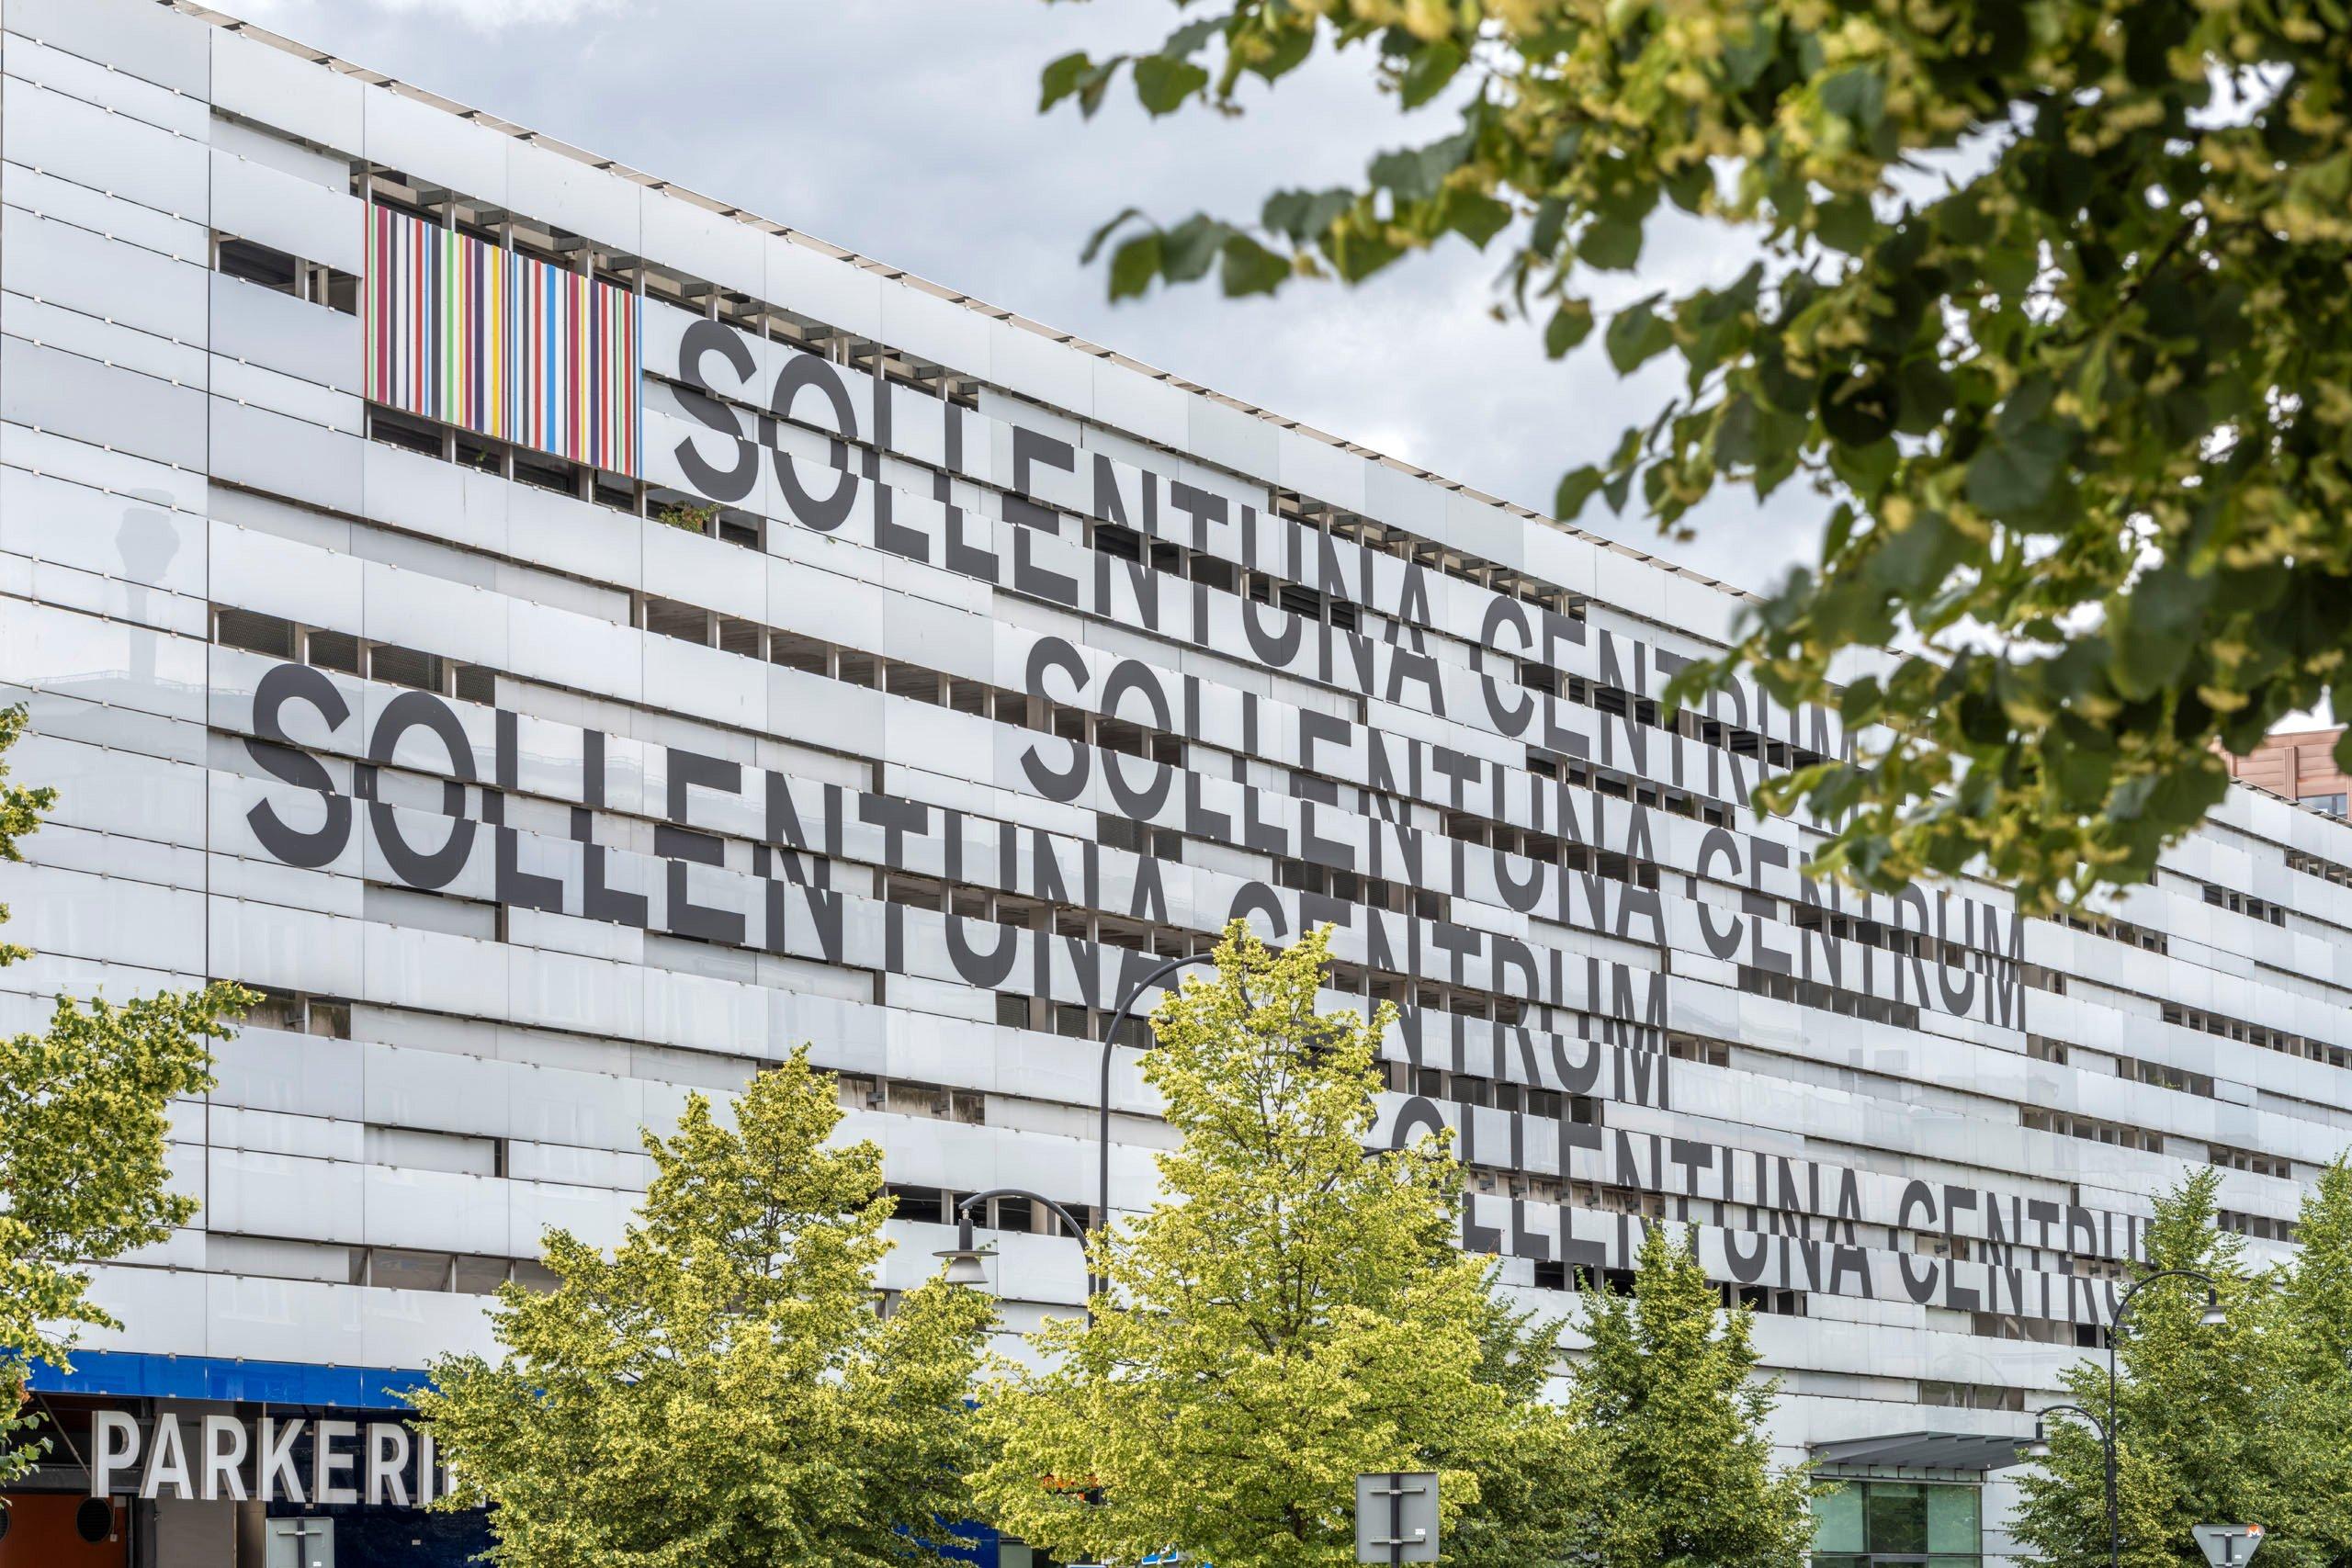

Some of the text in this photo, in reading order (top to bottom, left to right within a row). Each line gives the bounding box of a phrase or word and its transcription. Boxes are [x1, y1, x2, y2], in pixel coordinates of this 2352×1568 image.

[670, 319, 1446, 716] SOLLENTUNA
[243, 663, 1182, 1020] SOLLENTUNA
[1020, 637, 1668, 947] SOLLENTUNA
[1362, 1091, 1873, 1299] LLENTUNA
